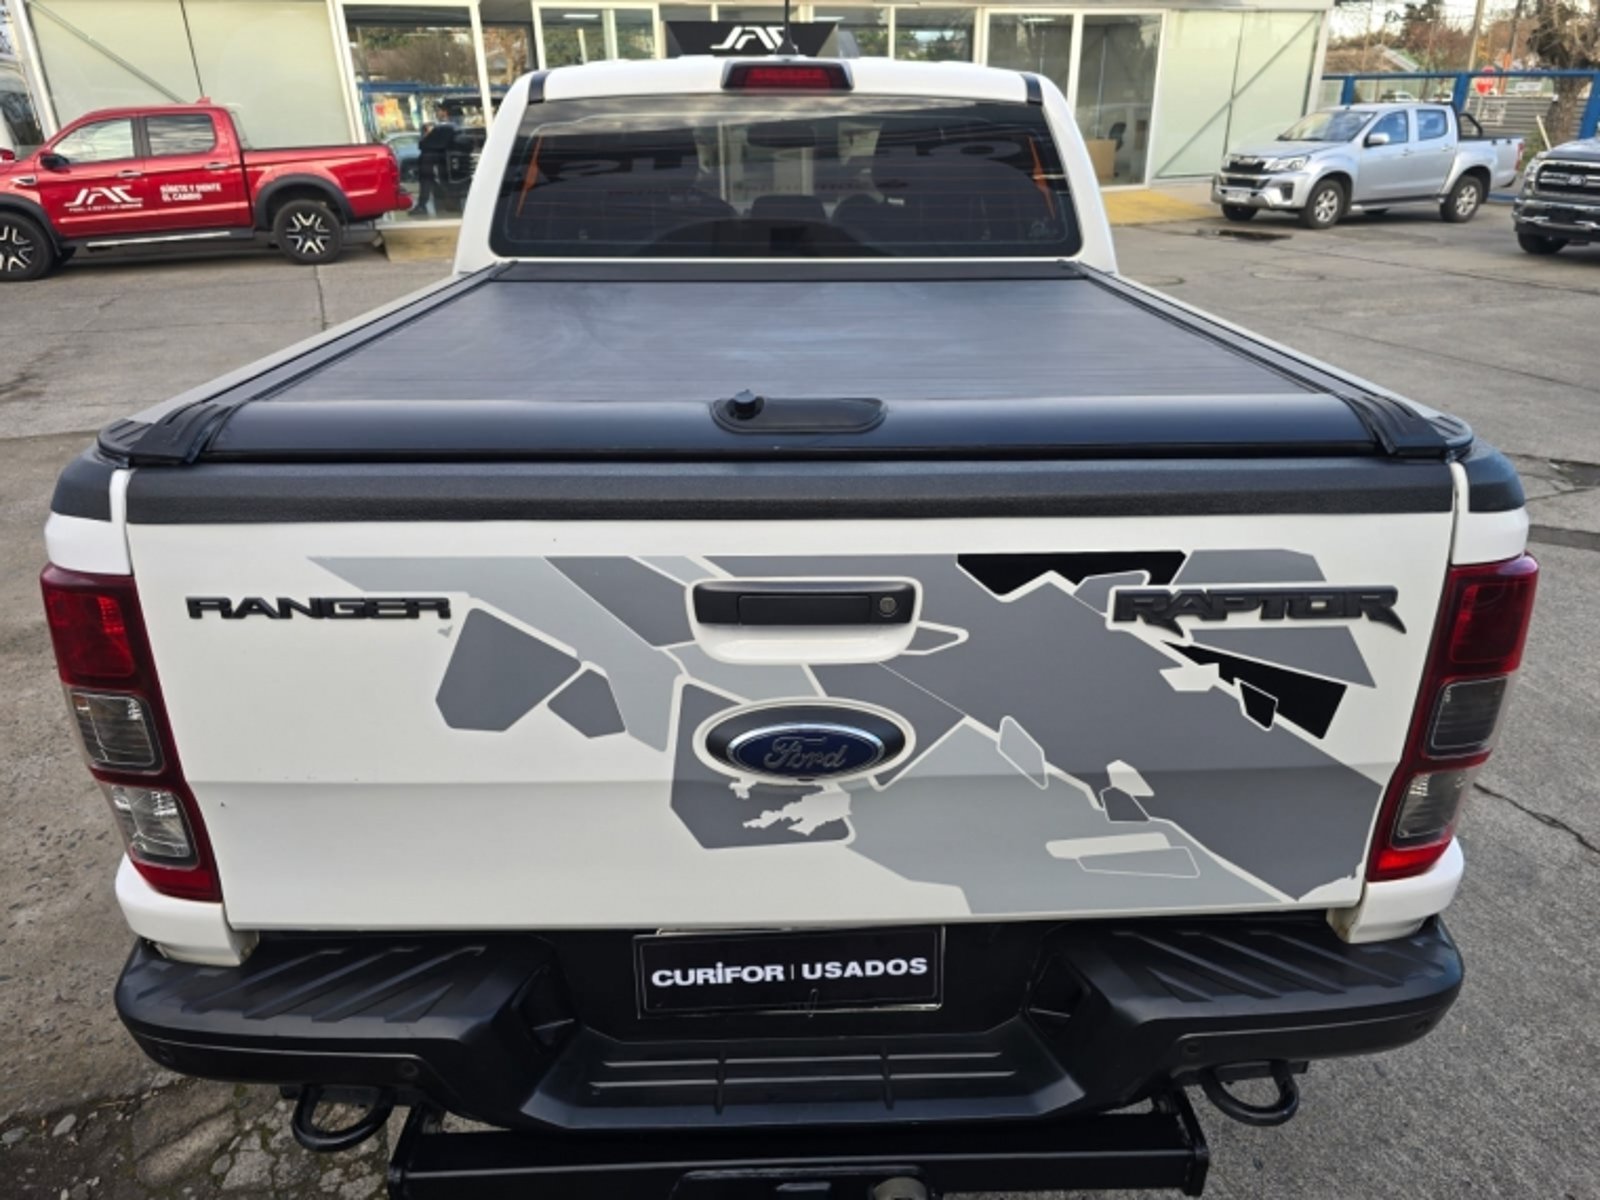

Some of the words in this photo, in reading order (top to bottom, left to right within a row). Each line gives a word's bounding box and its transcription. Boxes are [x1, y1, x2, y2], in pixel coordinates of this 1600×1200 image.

[185, 596, 451, 620] RANGER
[1112, 585, 1407, 638] RAPTOR
[763, 735, 849, 769] Ford
[801, 957, 928, 980] USADOS
